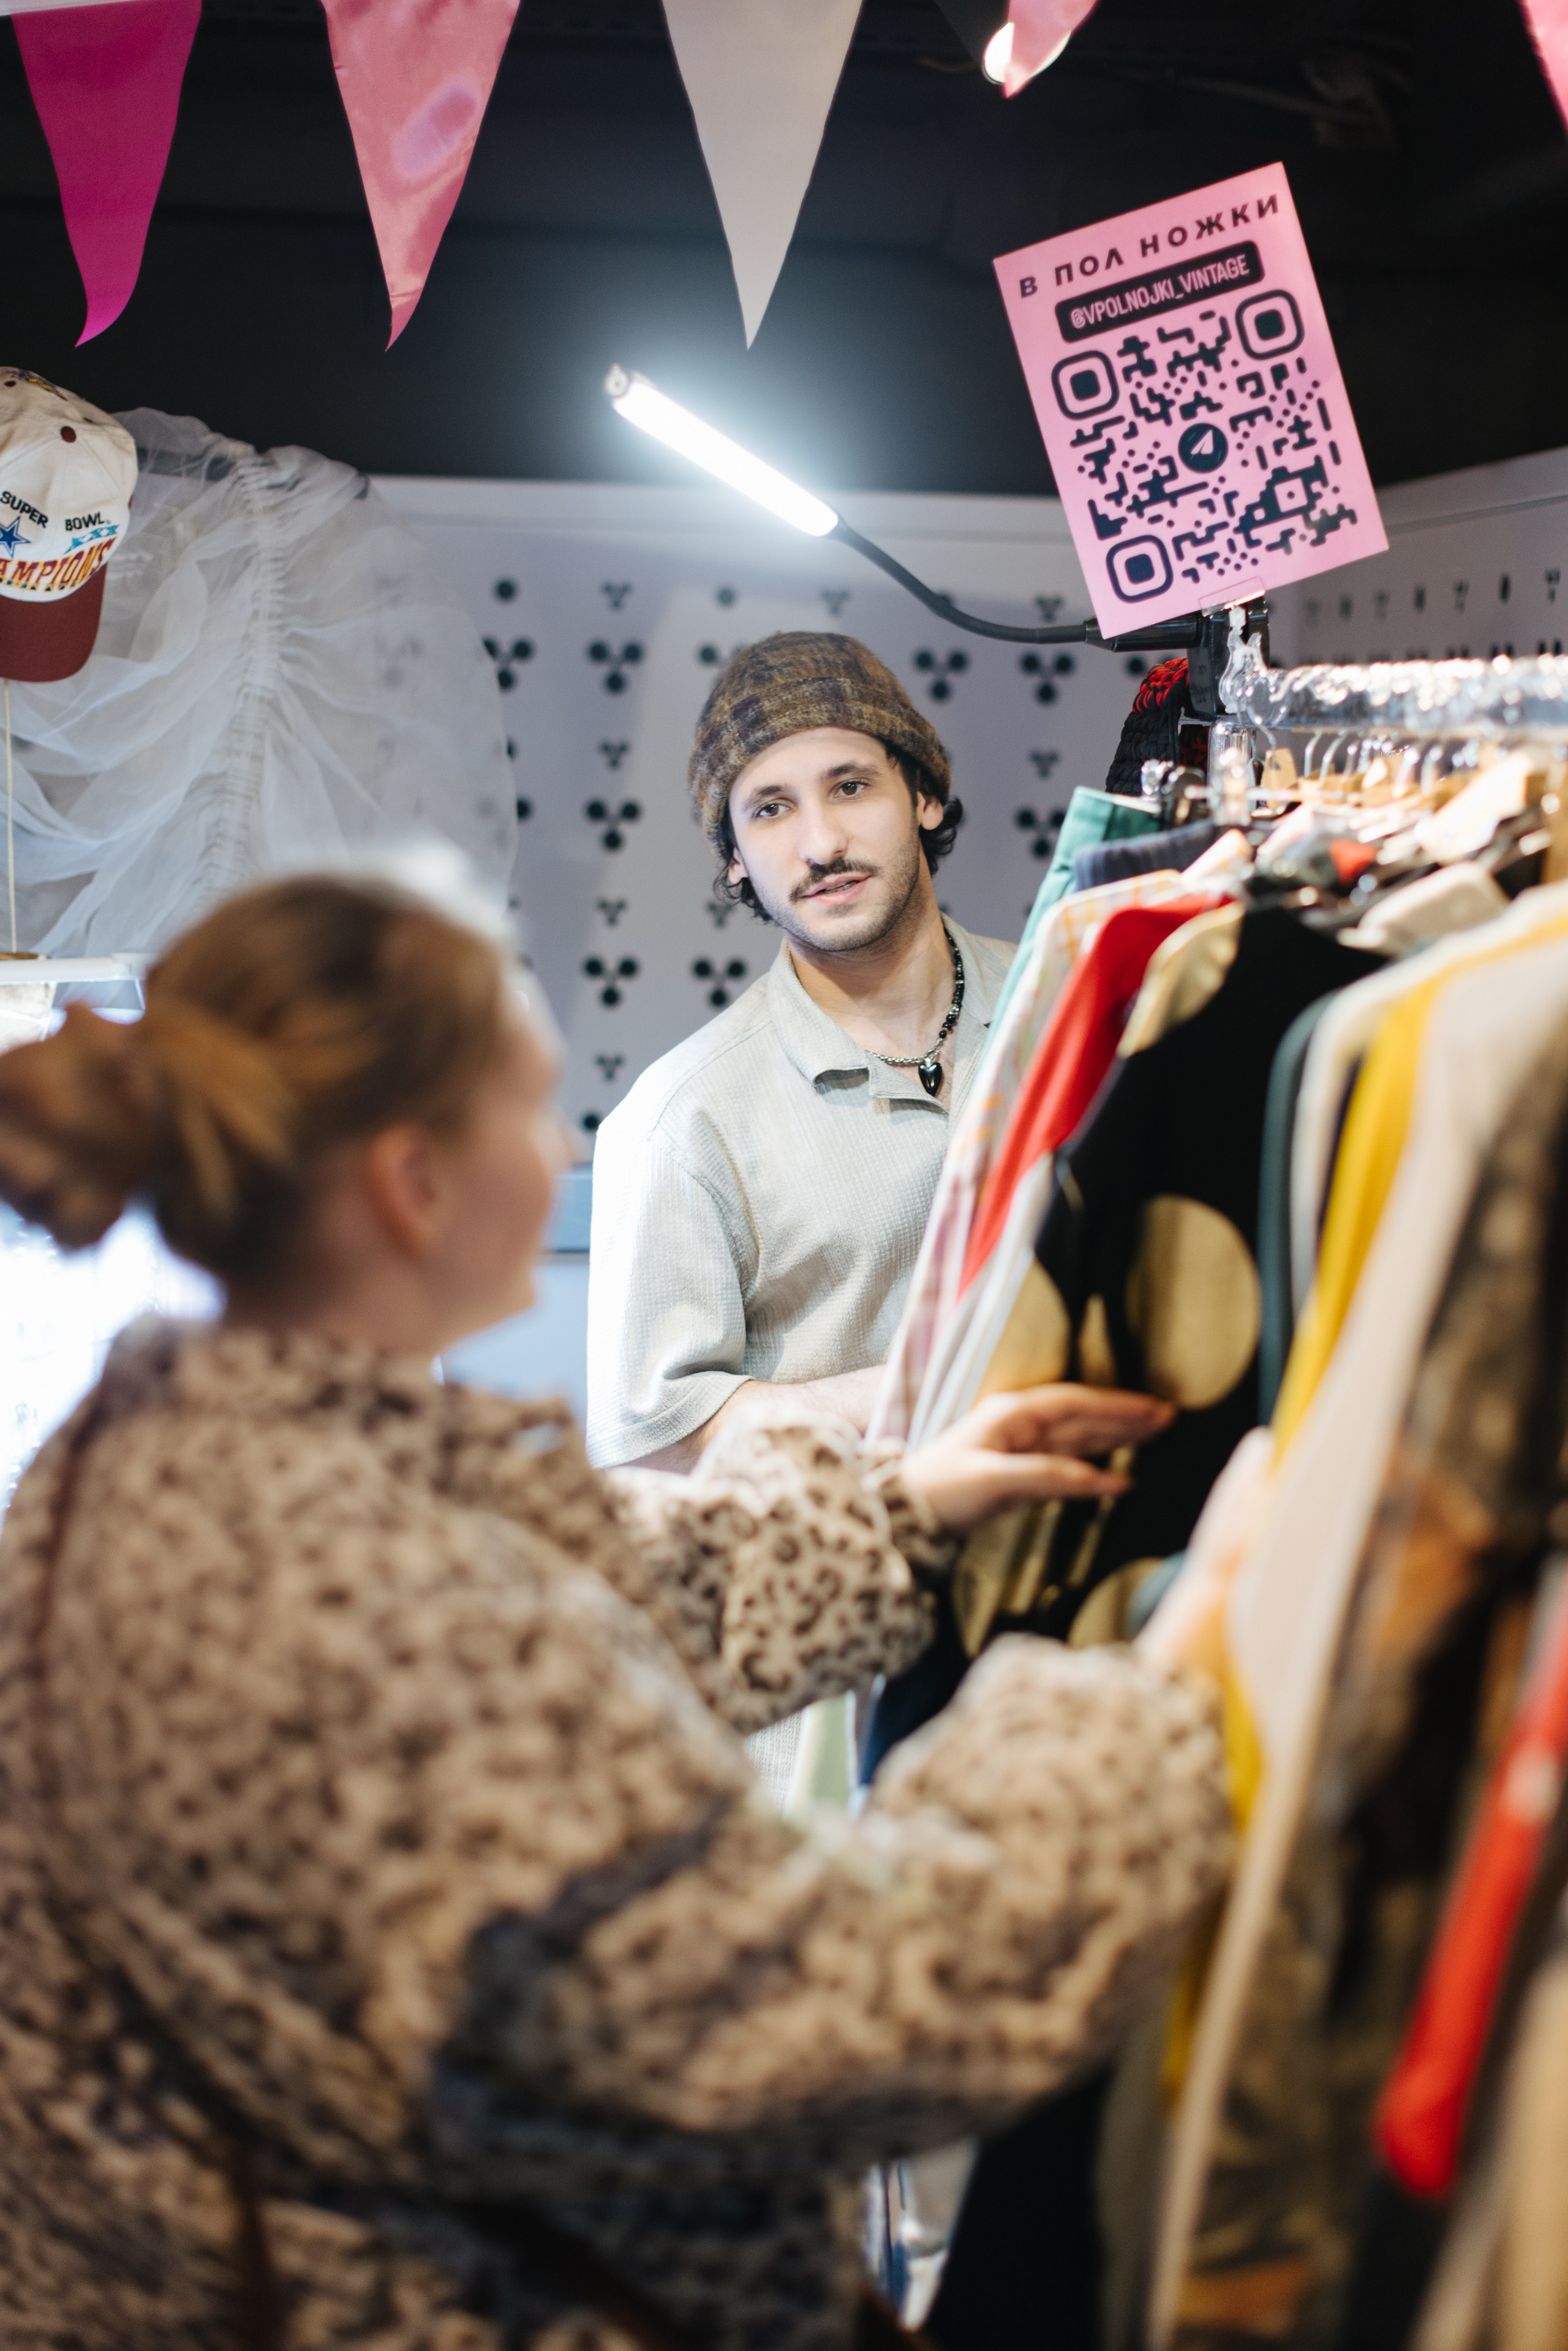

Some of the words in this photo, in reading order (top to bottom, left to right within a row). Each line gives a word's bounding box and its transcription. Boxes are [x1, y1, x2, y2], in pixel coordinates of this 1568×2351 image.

[1019, 276, 1038, 298] В
[1054, 247, 1125, 287] ПОЛ
[1139, 194, 1279, 258] НОЖКИ
[1070, 254, 1250, 330] @VPOLNOJKI_VINTAGE
[0, 491, 49, 529] SUPER
[65, 512, 105, 531] BOWL
